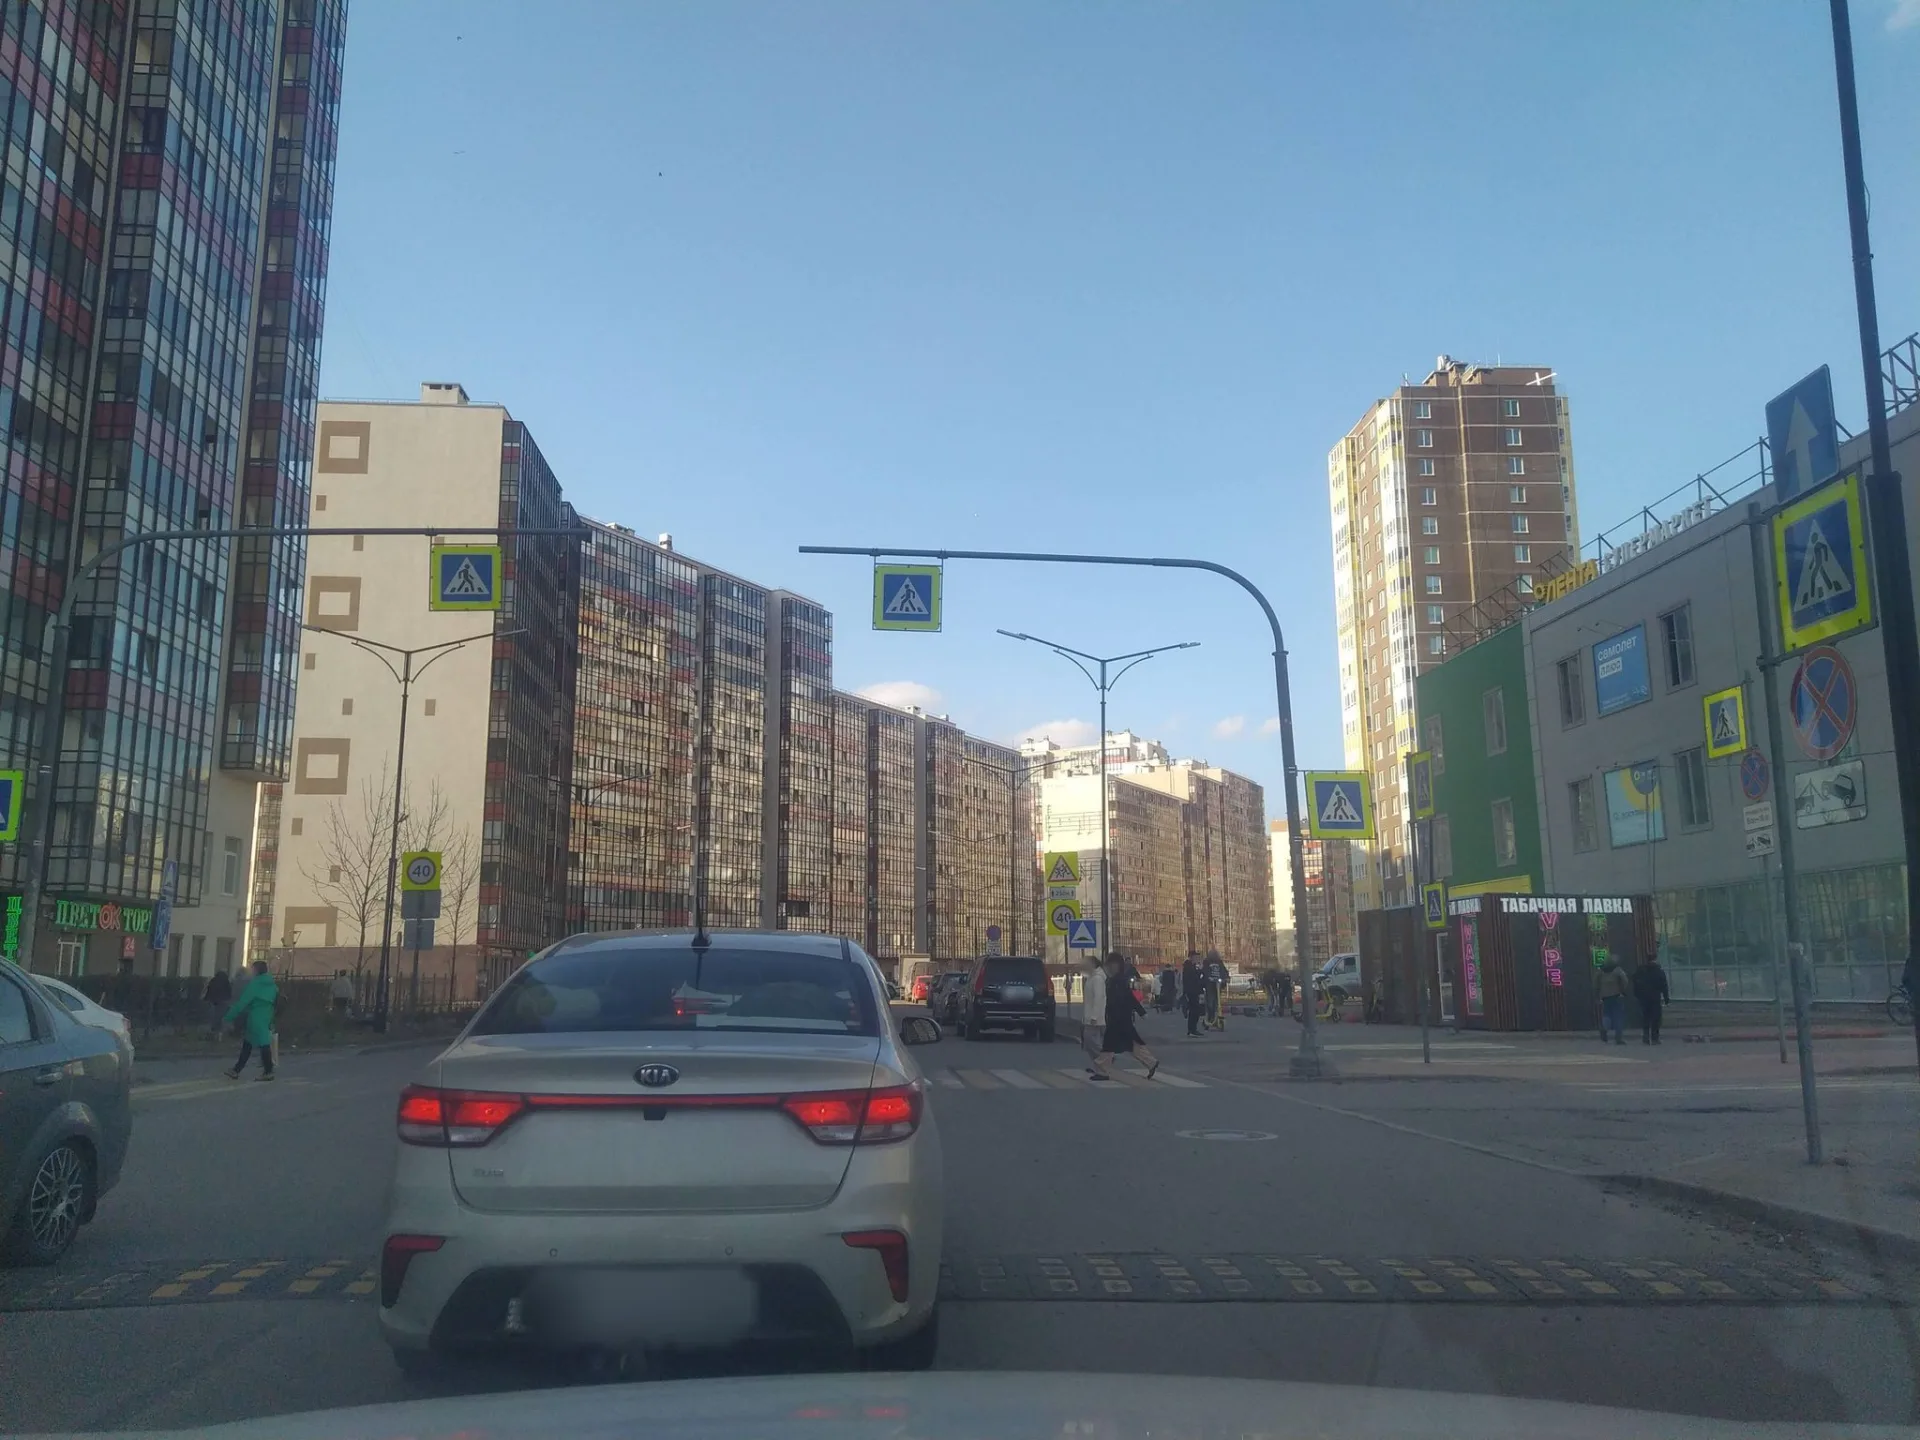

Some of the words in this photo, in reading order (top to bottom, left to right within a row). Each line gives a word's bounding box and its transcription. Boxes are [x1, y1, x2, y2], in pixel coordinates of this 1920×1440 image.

[1545, 558, 1599, 603] ЛЕНТА
[1602, 494, 1713, 573] СУПЕРМАРКЕТ
[1597, 635, 1638, 661] самолет
[411, 864, 431, 877] 40
[1500, 898, 1577, 913] ТАБАЧНАЯ
[1582, 898, 1633, 914] ЛАВКА
[1056, 912, 1072, 923] 40
[124, 937, 136, 951] 24
[640, 1069, 670, 1083] KIA
